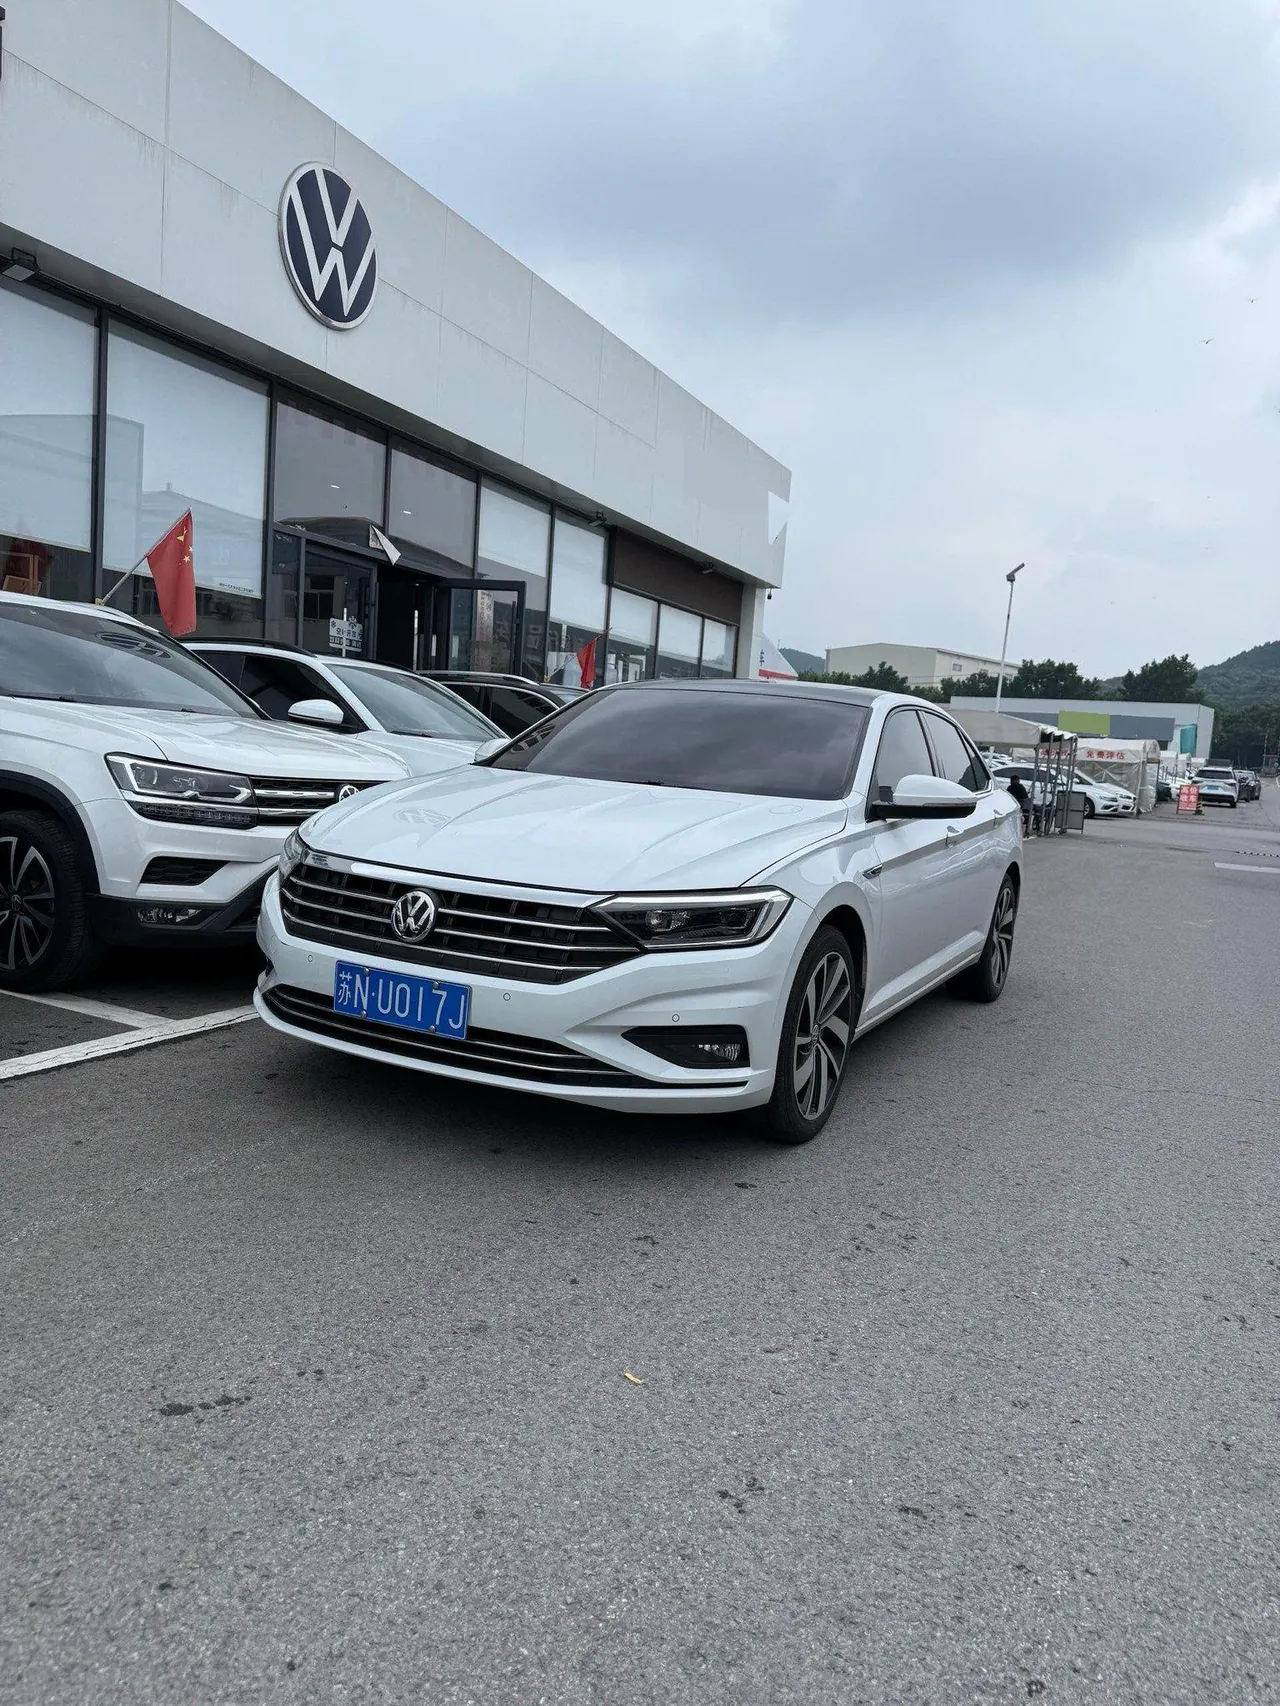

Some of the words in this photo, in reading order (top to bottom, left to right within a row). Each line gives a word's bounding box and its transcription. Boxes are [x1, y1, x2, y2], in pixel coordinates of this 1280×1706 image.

[282, 165, 377, 322] VW
[1086, 749, 1125, 760] 免费评估
[392, 891, 434, 938] VW
[337, 970, 466, 1030] 苏N·U017J
